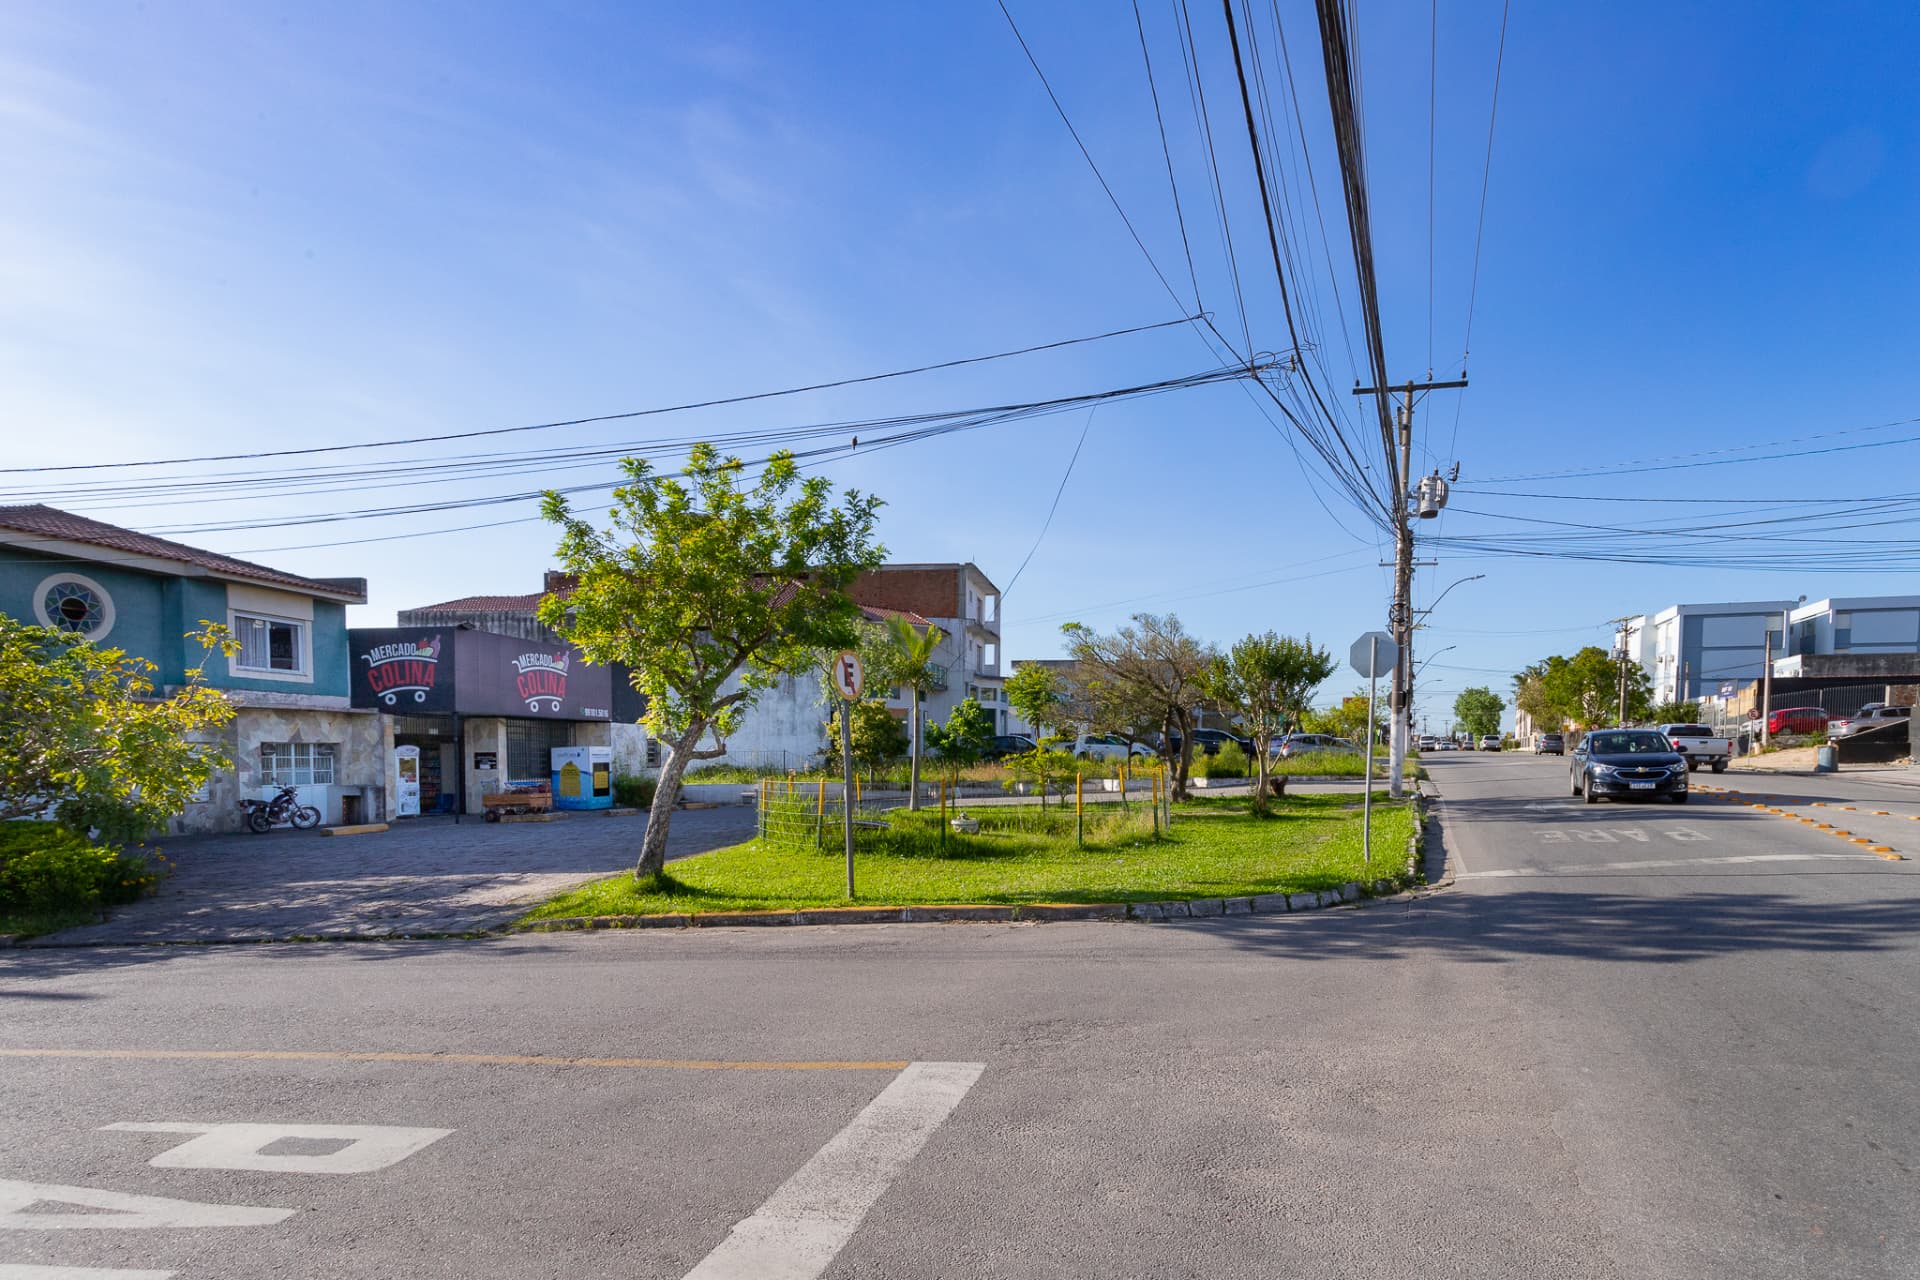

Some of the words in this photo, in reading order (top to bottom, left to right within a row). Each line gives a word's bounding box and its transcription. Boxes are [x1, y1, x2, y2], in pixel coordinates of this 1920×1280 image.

[370, 643, 416, 661] MERCADO
[519, 653, 553, 668] MERCADO
[367, 660, 435, 692] COLINA
[517, 673, 567, 698] COLINA
[1532, 826, 1713, 843] PARE
